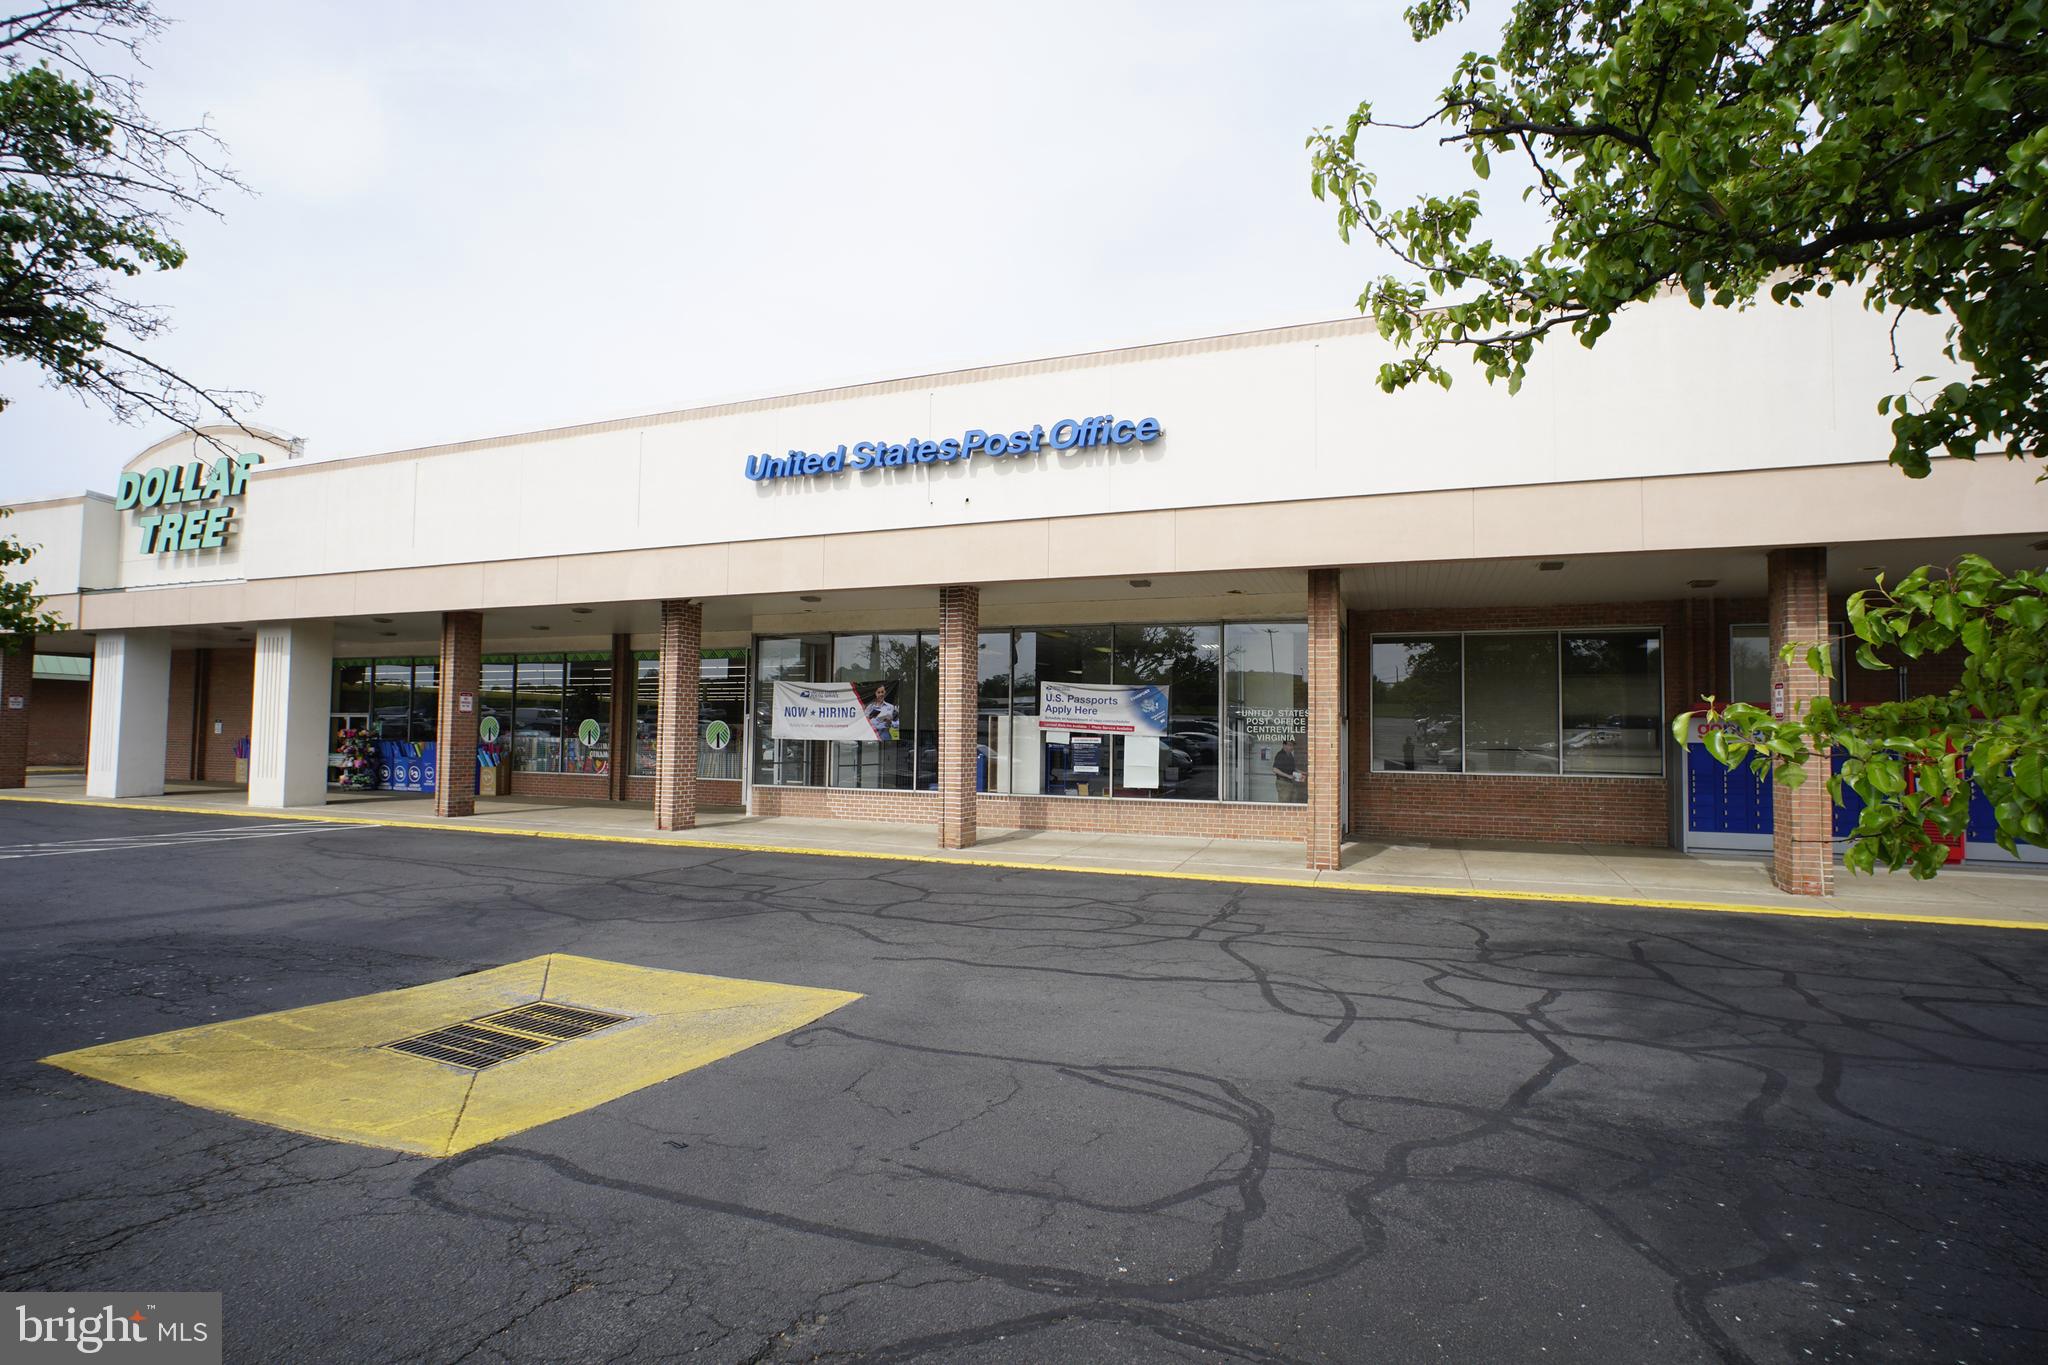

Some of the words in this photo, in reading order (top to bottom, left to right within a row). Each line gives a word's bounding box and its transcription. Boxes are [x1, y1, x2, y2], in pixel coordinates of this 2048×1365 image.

[745, 444, 847, 481] United
[850, 437, 962, 472] States
[961, 424, 1044, 459] Post
[1050, 415, 1161, 450] Office
[139, 507, 234, 554] TREE
[1045, 694, 1064, 703] U.S.
[1067, 694, 1118, 705] Passports
[784, 706, 808, 718] NOW
[819, 706, 856, 718] HIRING
[1045, 704, 1073, 715] Apply
[1074, 706, 1098, 715] Here
[1241, 709, 1274, 717] UNITED
[1246, 717, 1270, 725] POST
[1273, 717, 1306, 725] OFFICE
[1246, 725, 1306, 733] CENTREVILLE
